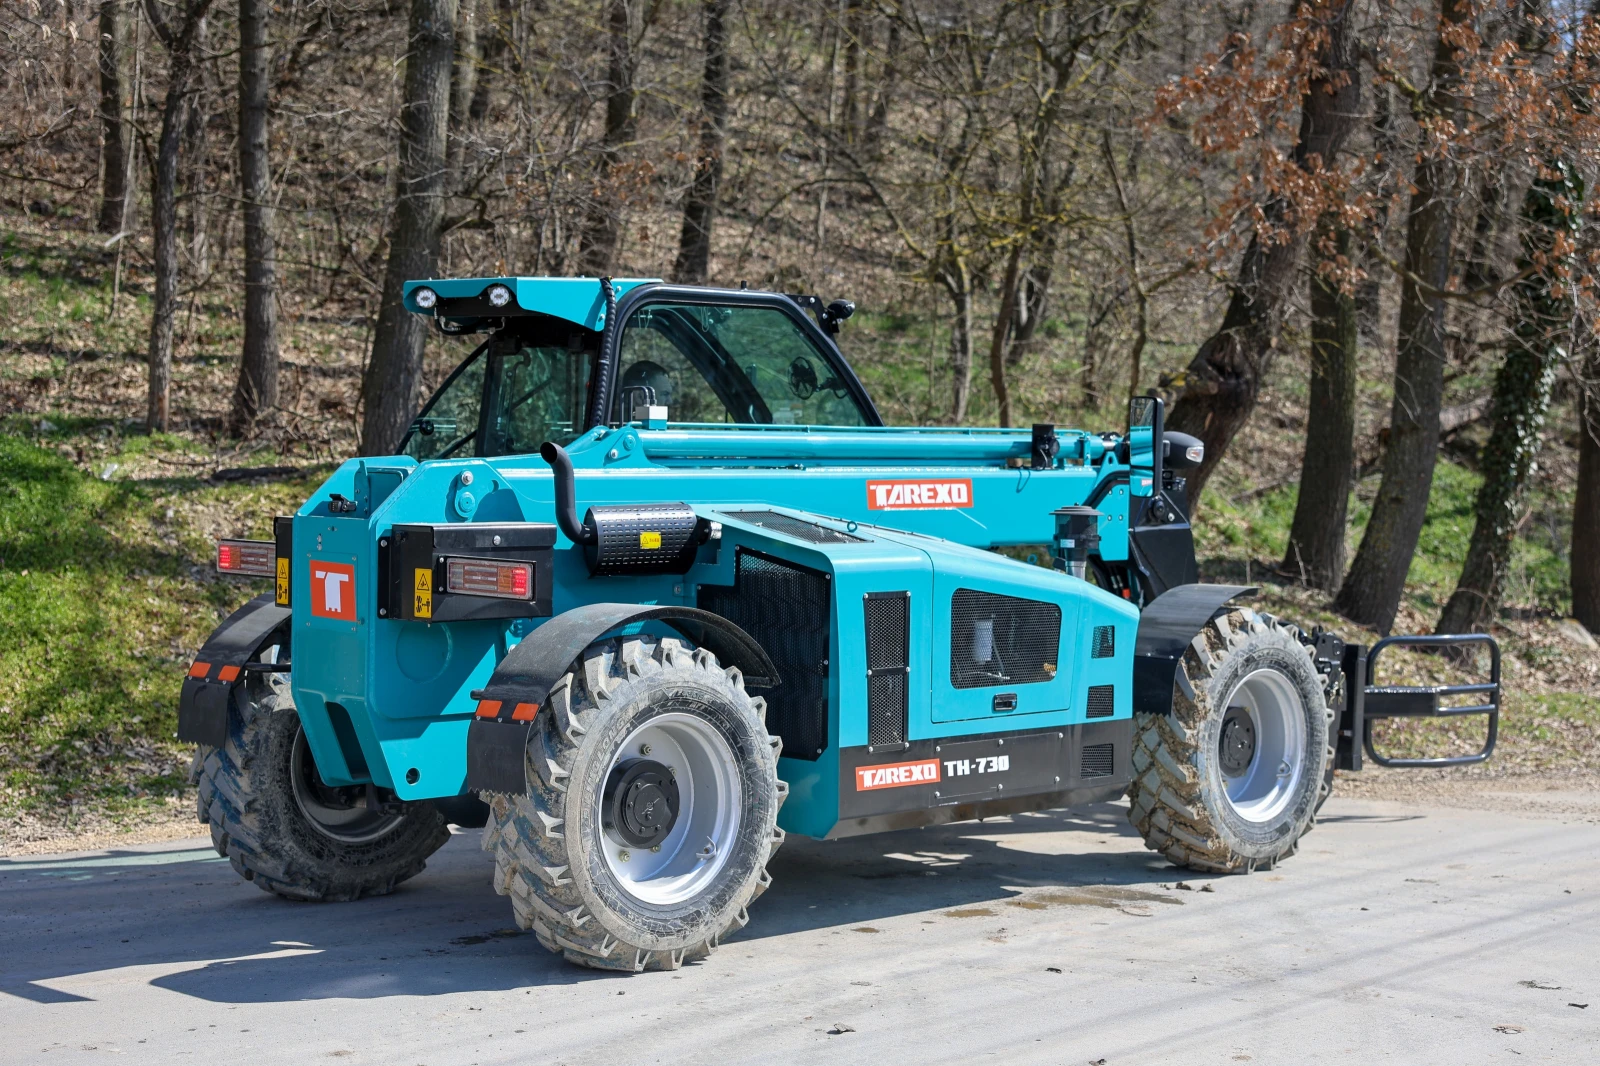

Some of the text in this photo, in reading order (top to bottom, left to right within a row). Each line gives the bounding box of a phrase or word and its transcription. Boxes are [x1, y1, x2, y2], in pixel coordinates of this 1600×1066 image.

[869, 483, 968, 507] TAREXO
[315, 569, 349, 613] T
[859, 754, 1010, 788] TAREXO TH-730
